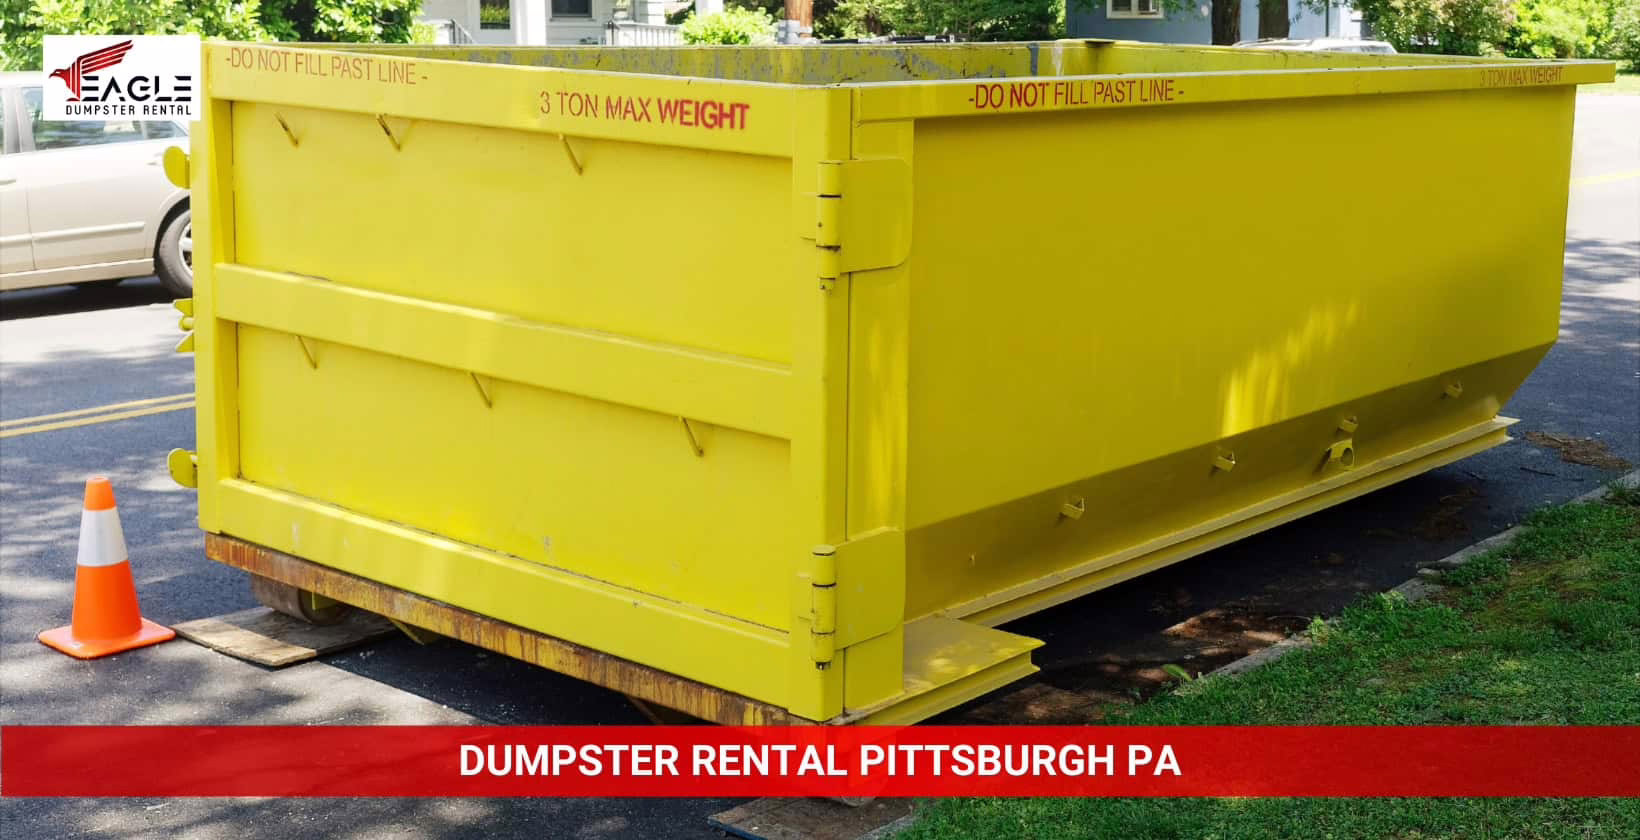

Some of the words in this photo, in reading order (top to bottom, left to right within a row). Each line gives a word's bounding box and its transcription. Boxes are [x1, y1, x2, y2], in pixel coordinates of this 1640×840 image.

[258, 50, 290, 73] NOT
[295, 53, 327, 77] FILL
[331, 56, 373, 81] PAST
[379, 63, 416, 85] LINE
[1529, 66, 1564, 84] WEIGHT
[1010, 82, 1050, 108] NOT
[1054, 81, 1089, 105] FILL
[1094, 80, 1136, 104] PAST
[1140, 79, 1174, 103] LINE
[540, 91, 550, 114] 3
[556, 91, 598, 118] TON
[606, 95, 651, 123] MAX
[657, 98, 750, 130] WEIGHT
